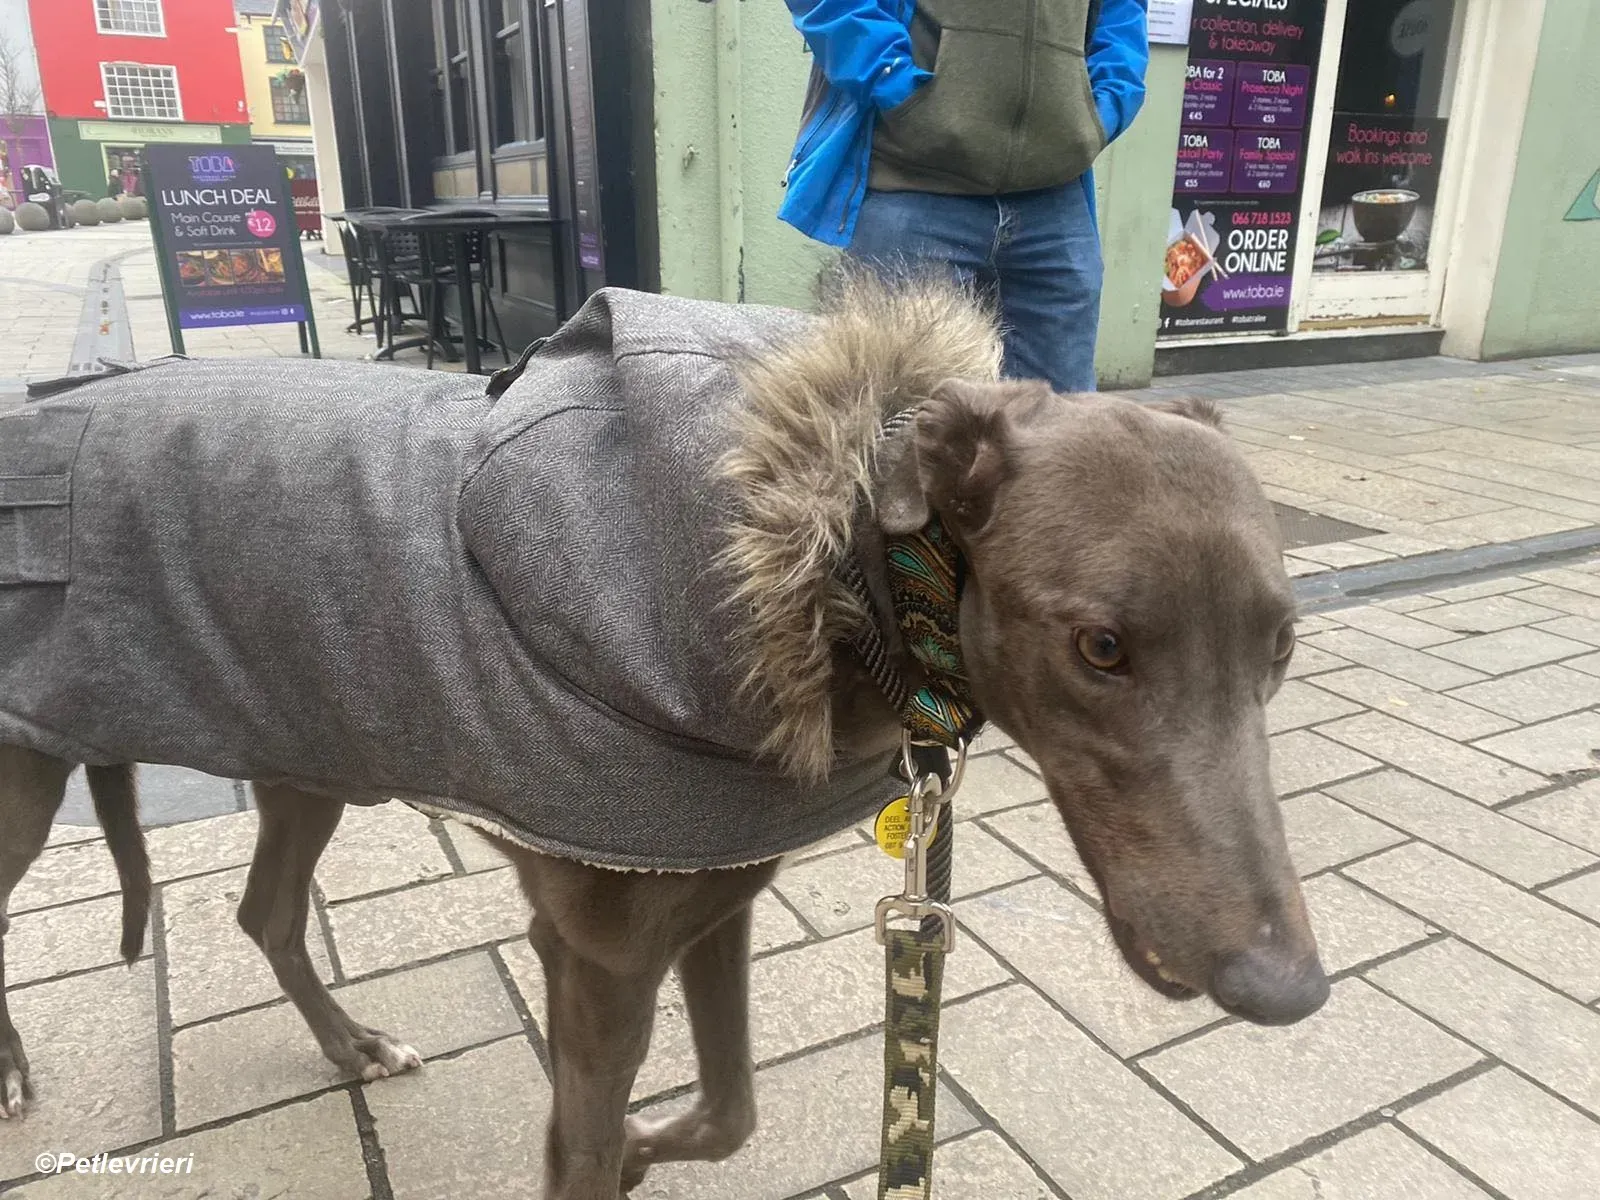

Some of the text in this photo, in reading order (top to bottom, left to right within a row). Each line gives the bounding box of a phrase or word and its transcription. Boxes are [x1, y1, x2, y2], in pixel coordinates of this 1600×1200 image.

[1206, 0, 1288, 11] ECIALS
[1262, 20, 1304, 39] delivery
[1208, 33, 1276, 55] & takeaway
[1185, 65, 1224, 80] OBA for 2
[1262, 70, 1286, 83] TOBA
[1192, 79, 1224, 91] Classic
[1241, 81, 1303, 96] Prosecco Night
[1263, 114, 1275, 123] €55
[1183, 135, 1208, 147] TOBA
[1347, 122, 1429, 147] Bookings and
[1257, 137, 1281, 149] TOBA
[1202, 148, 1224, 161] Party
[1266, 148, 1296, 161] Special
[1336, 146, 1362, 164] walk
[1383, 149, 1433, 165] welcome
[188, 155, 235, 173] TOBA
[1184, 179, 1198, 188] €55
[161, 189, 228, 206] LUNCH
[231, 188, 277, 205] DEAL
[170, 211, 241, 224] Main Course
[1231, 212, 1292, 225] 066 718 1523
[174, 224, 237, 237] & Soft Drink
[1228, 229, 1289, 250] ORDER
[1225, 251, 1287, 273] ONLINE
[1223, 284, 1284, 299] www.toba.ie
[189, 309, 245, 320] www.toba.ie
[886, 832, 910, 840] FOSTE
